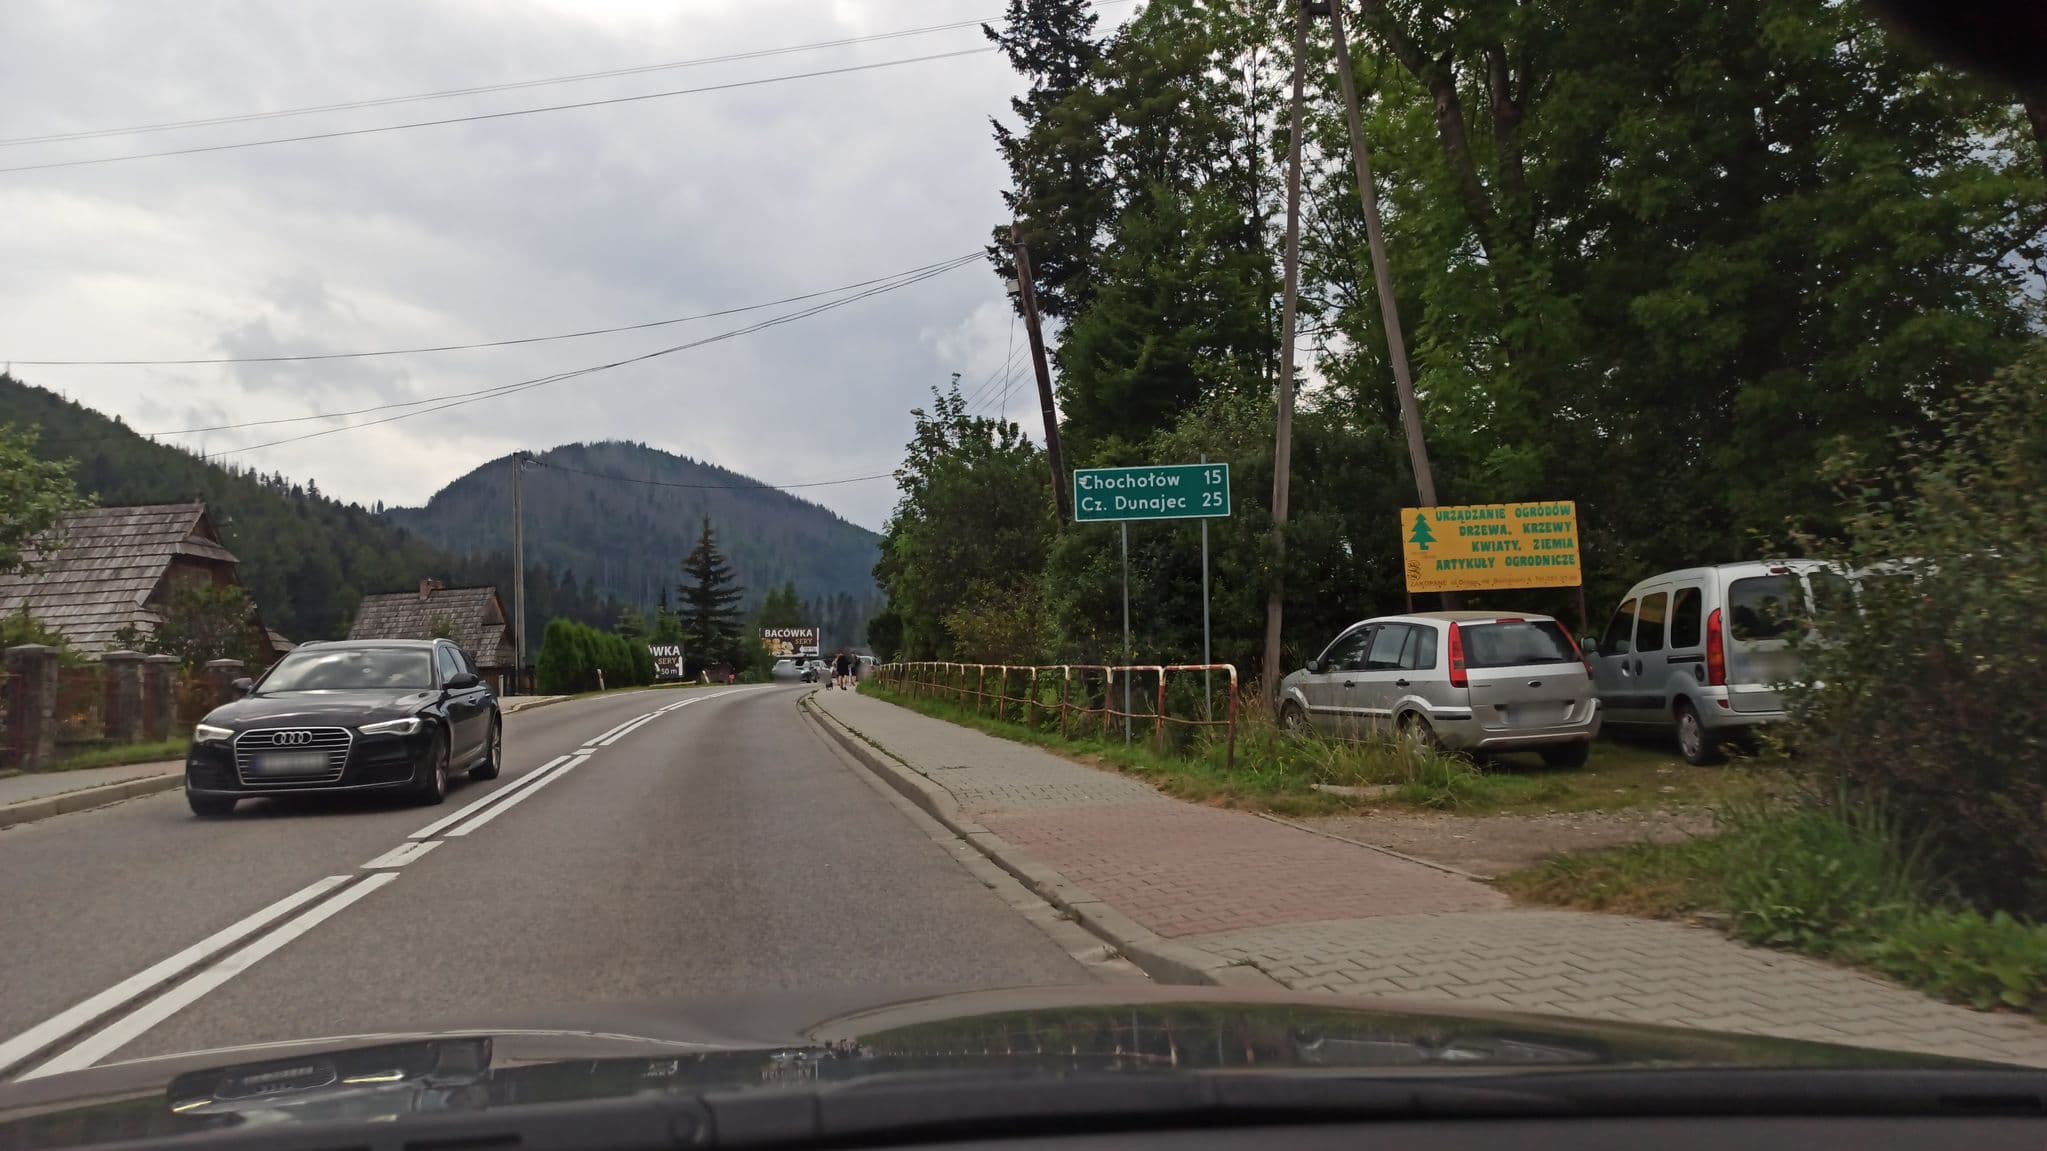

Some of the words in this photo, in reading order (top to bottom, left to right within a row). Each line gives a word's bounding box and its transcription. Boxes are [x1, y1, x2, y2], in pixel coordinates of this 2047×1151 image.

[1080, 472, 1180, 490] Chochołów
[1204, 470, 1222, 484] 15
[1082, 497, 1107, 511] Cz.
[1115, 495, 1186, 512] Dunajec
[1202, 492, 1222, 507] 25
[1436, 508, 1505, 524] URZĄDZANIE
[1515, 505, 1571, 518] OGRODÓW
[1523, 522, 1572, 533] KRZEWY
[1533, 538, 1574, 550] ZIEMIA
[1436, 557, 1495, 571] ARTYKUŁY
[1505, 554, 1575, 567] OGRODNICZE
[765, 628, 813, 637] BACÓWKA
